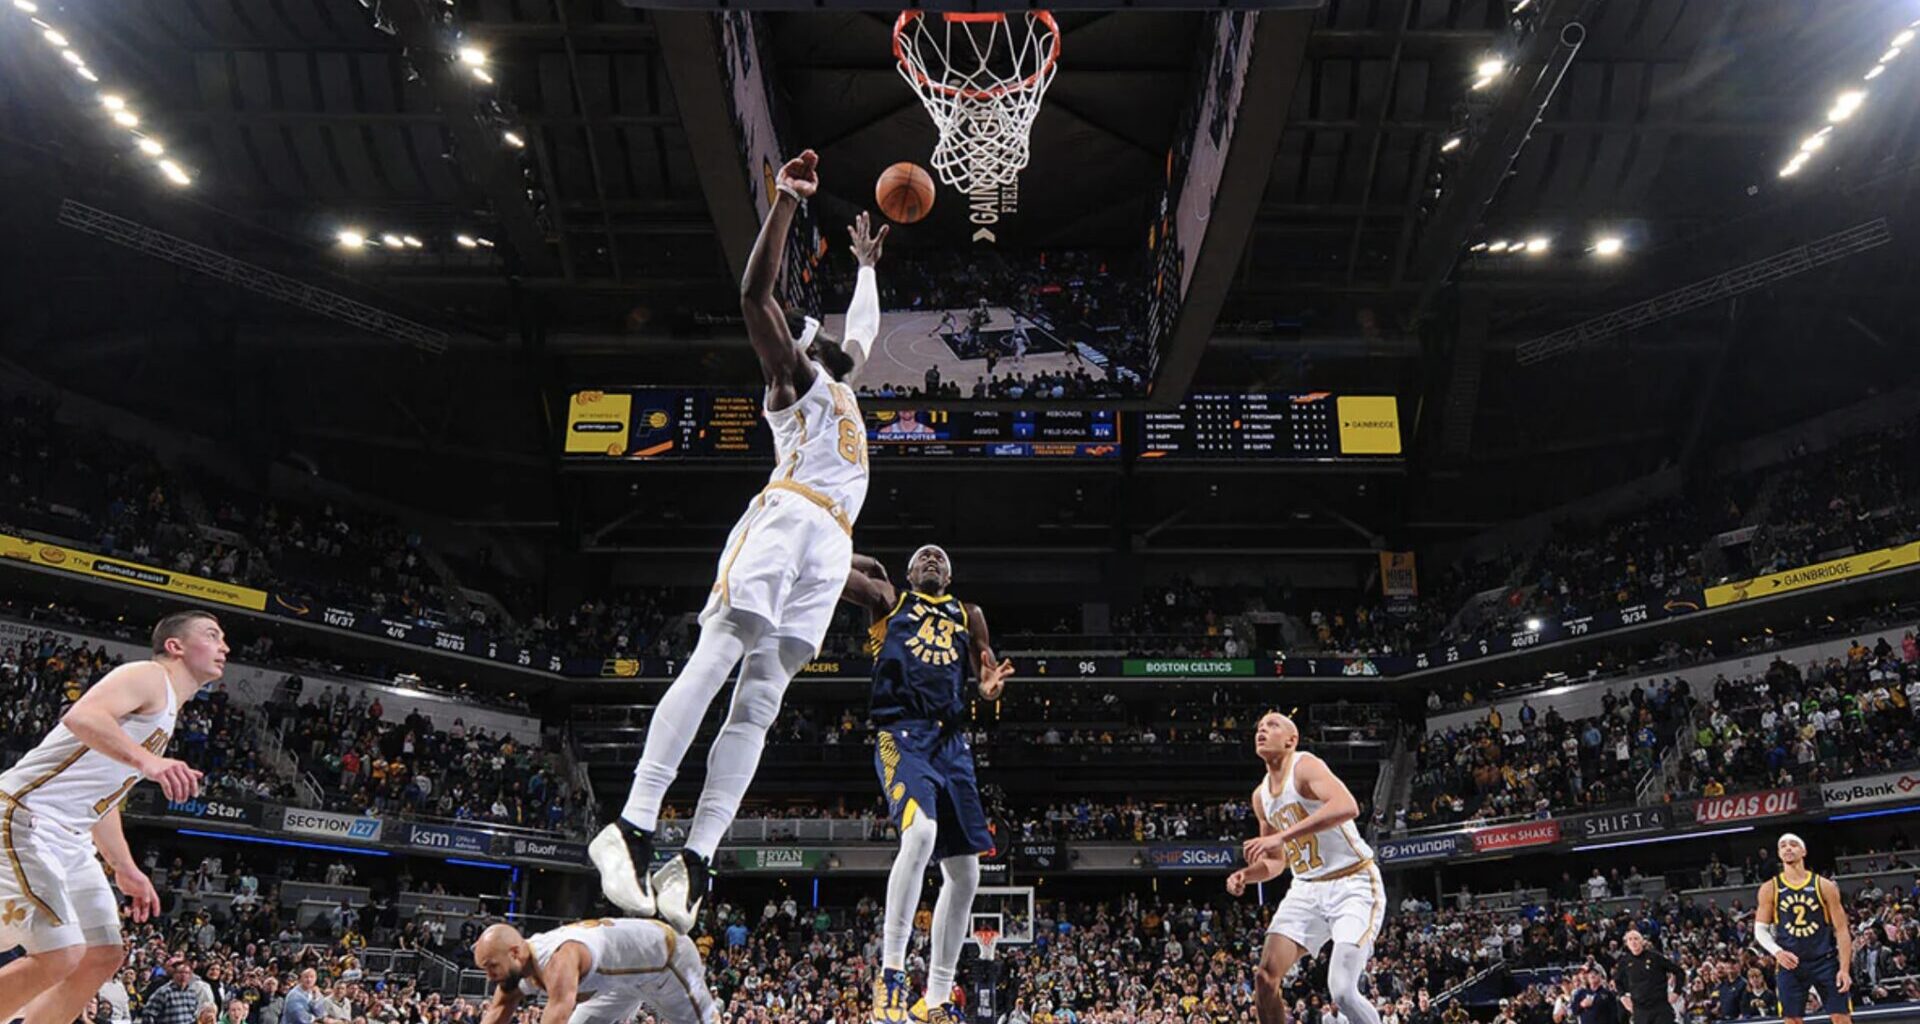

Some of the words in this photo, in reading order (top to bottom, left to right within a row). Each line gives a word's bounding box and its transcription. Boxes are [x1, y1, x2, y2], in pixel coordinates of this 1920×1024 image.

[97, 563, 137, 577] ultimate
[137, 572, 164, 583] assist
[170, 579, 184, 587] for
[186, 584, 205, 592] your
[1783, 561, 1852, 586] GAINBRIDGE
[324, 612, 355, 629] 16/37
[1621, 610, 1648, 625] 9/34
[386, 626, 405, 640] 4/6
[916, 615, 955, 650] 43
[1570, 624, 1588, 637] 7/9
[435, 636, 465, 652] 38/83
[1511, 633, 1540, 649] 40/87
[904, 635, 959, 665] PACERS
[1446, 651, 1459, 662] 22
[1480, 645, 1488, 655] 9
[518, 654, 530, 665] 29
[550, 660, 561, 671] 39
[1146, 662, 1188, 673] BOSTON
[1190, 662, 1232, 673] CELTICS
[1078, 661, 1096, 675] 96
[1823, 781, 1895, 806] KeyBank
[1696, 797, 1760, 822] LUCAS
[1764, 792, 1798, 815] OIL
[286, 813, 350, 834] SECTION
[352, 821, 374, 837] 127
[1585, 813, 1642, 837] SHIFT
[1650, 813, 1660, 824] 4
[409, 825, 450, 847] ksm
[1475, 834, 1510, 848] STEAK
[1518, 827, 1554, 842] SHAKE
[527, 842, 557, 857] Ruoff
[1024, 846, 1056, 855] CELTICS
[1284, 833, 1323, 874] 27
[1400, 838, 1456, 857] HYUNDAI
[767, 850, 803, 862] RYAN
[1779, 893, 1819, 912] INDIANA
[1792, 904, 1807, 925] 2
[1784, 921, 1819, 937] PACERS
